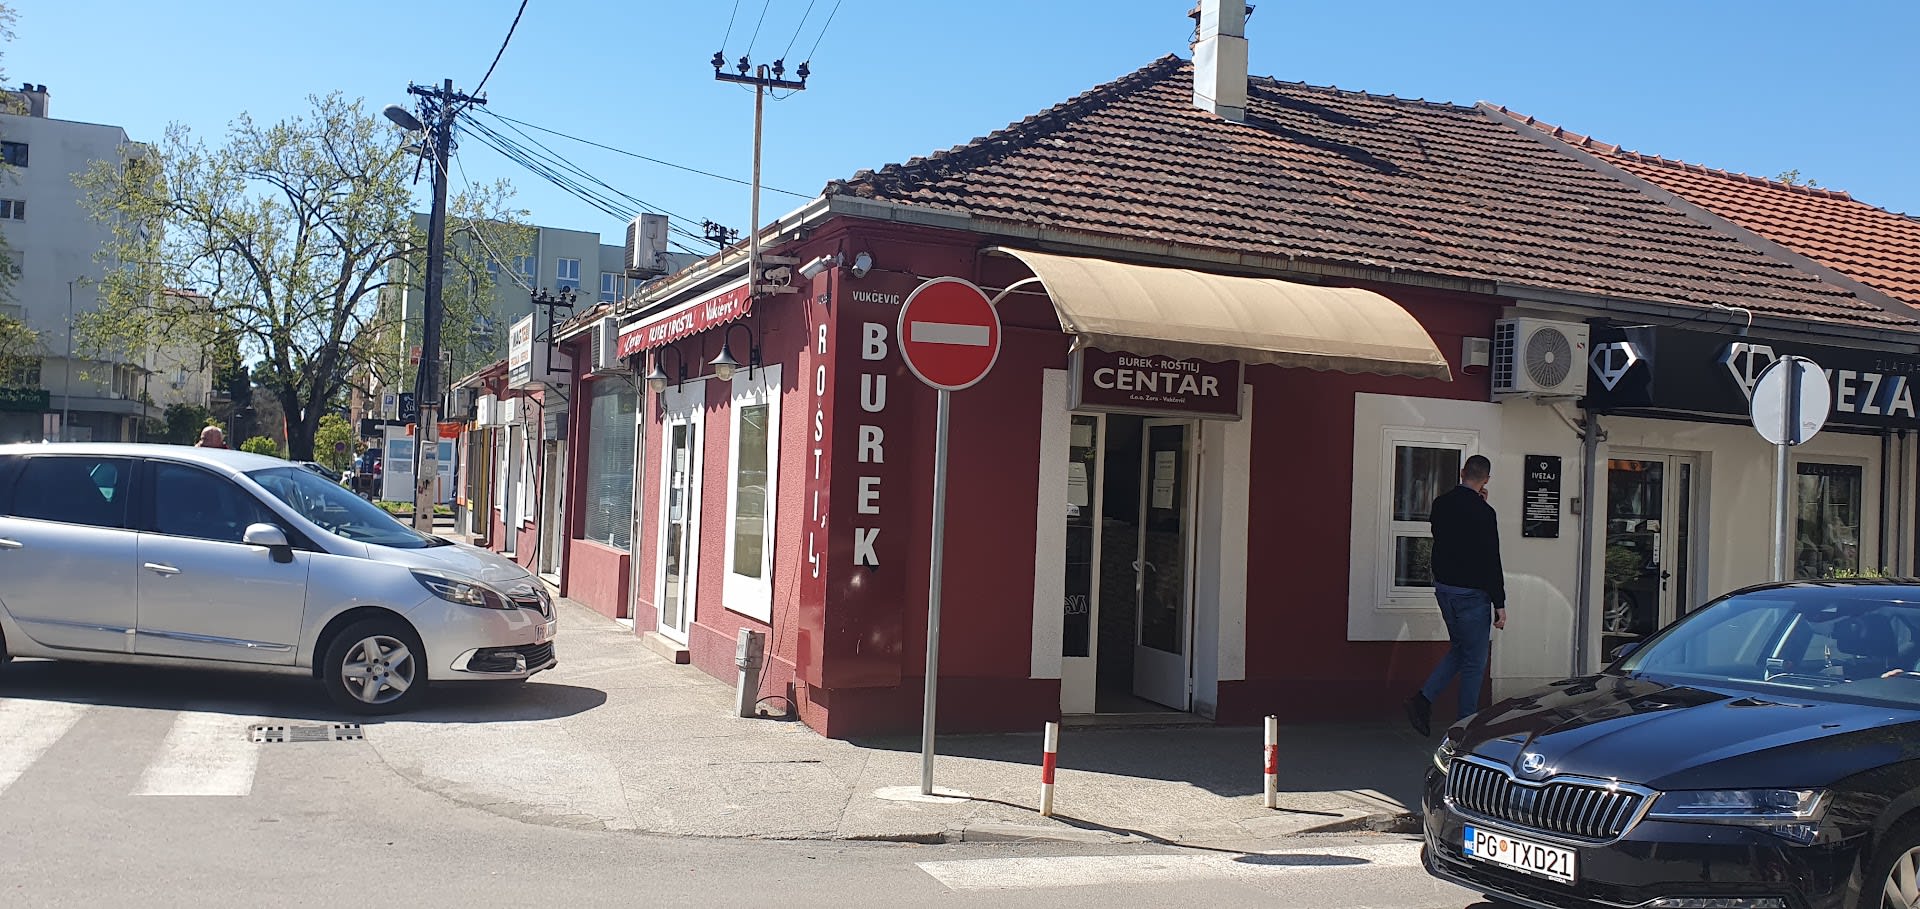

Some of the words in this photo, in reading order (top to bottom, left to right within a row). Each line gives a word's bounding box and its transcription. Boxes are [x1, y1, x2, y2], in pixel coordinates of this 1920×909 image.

[852, 289, 900, 305] VUKČEVIĆ
[1118, 357, 1153, 368] BUREK
[1161, 359, 1200, 374] ROŠTILJ
[1093, 368, 1219, 397] CENTAR
[808, 323, 827, 579] ROŠTILJ
[853, 322, 888, 566] BUREK
[1531, 472, 1556, 480] IVEZAJ
[1476, 832, 1497, 857] PG
[1510, 841, 1571, 877] TXD21
